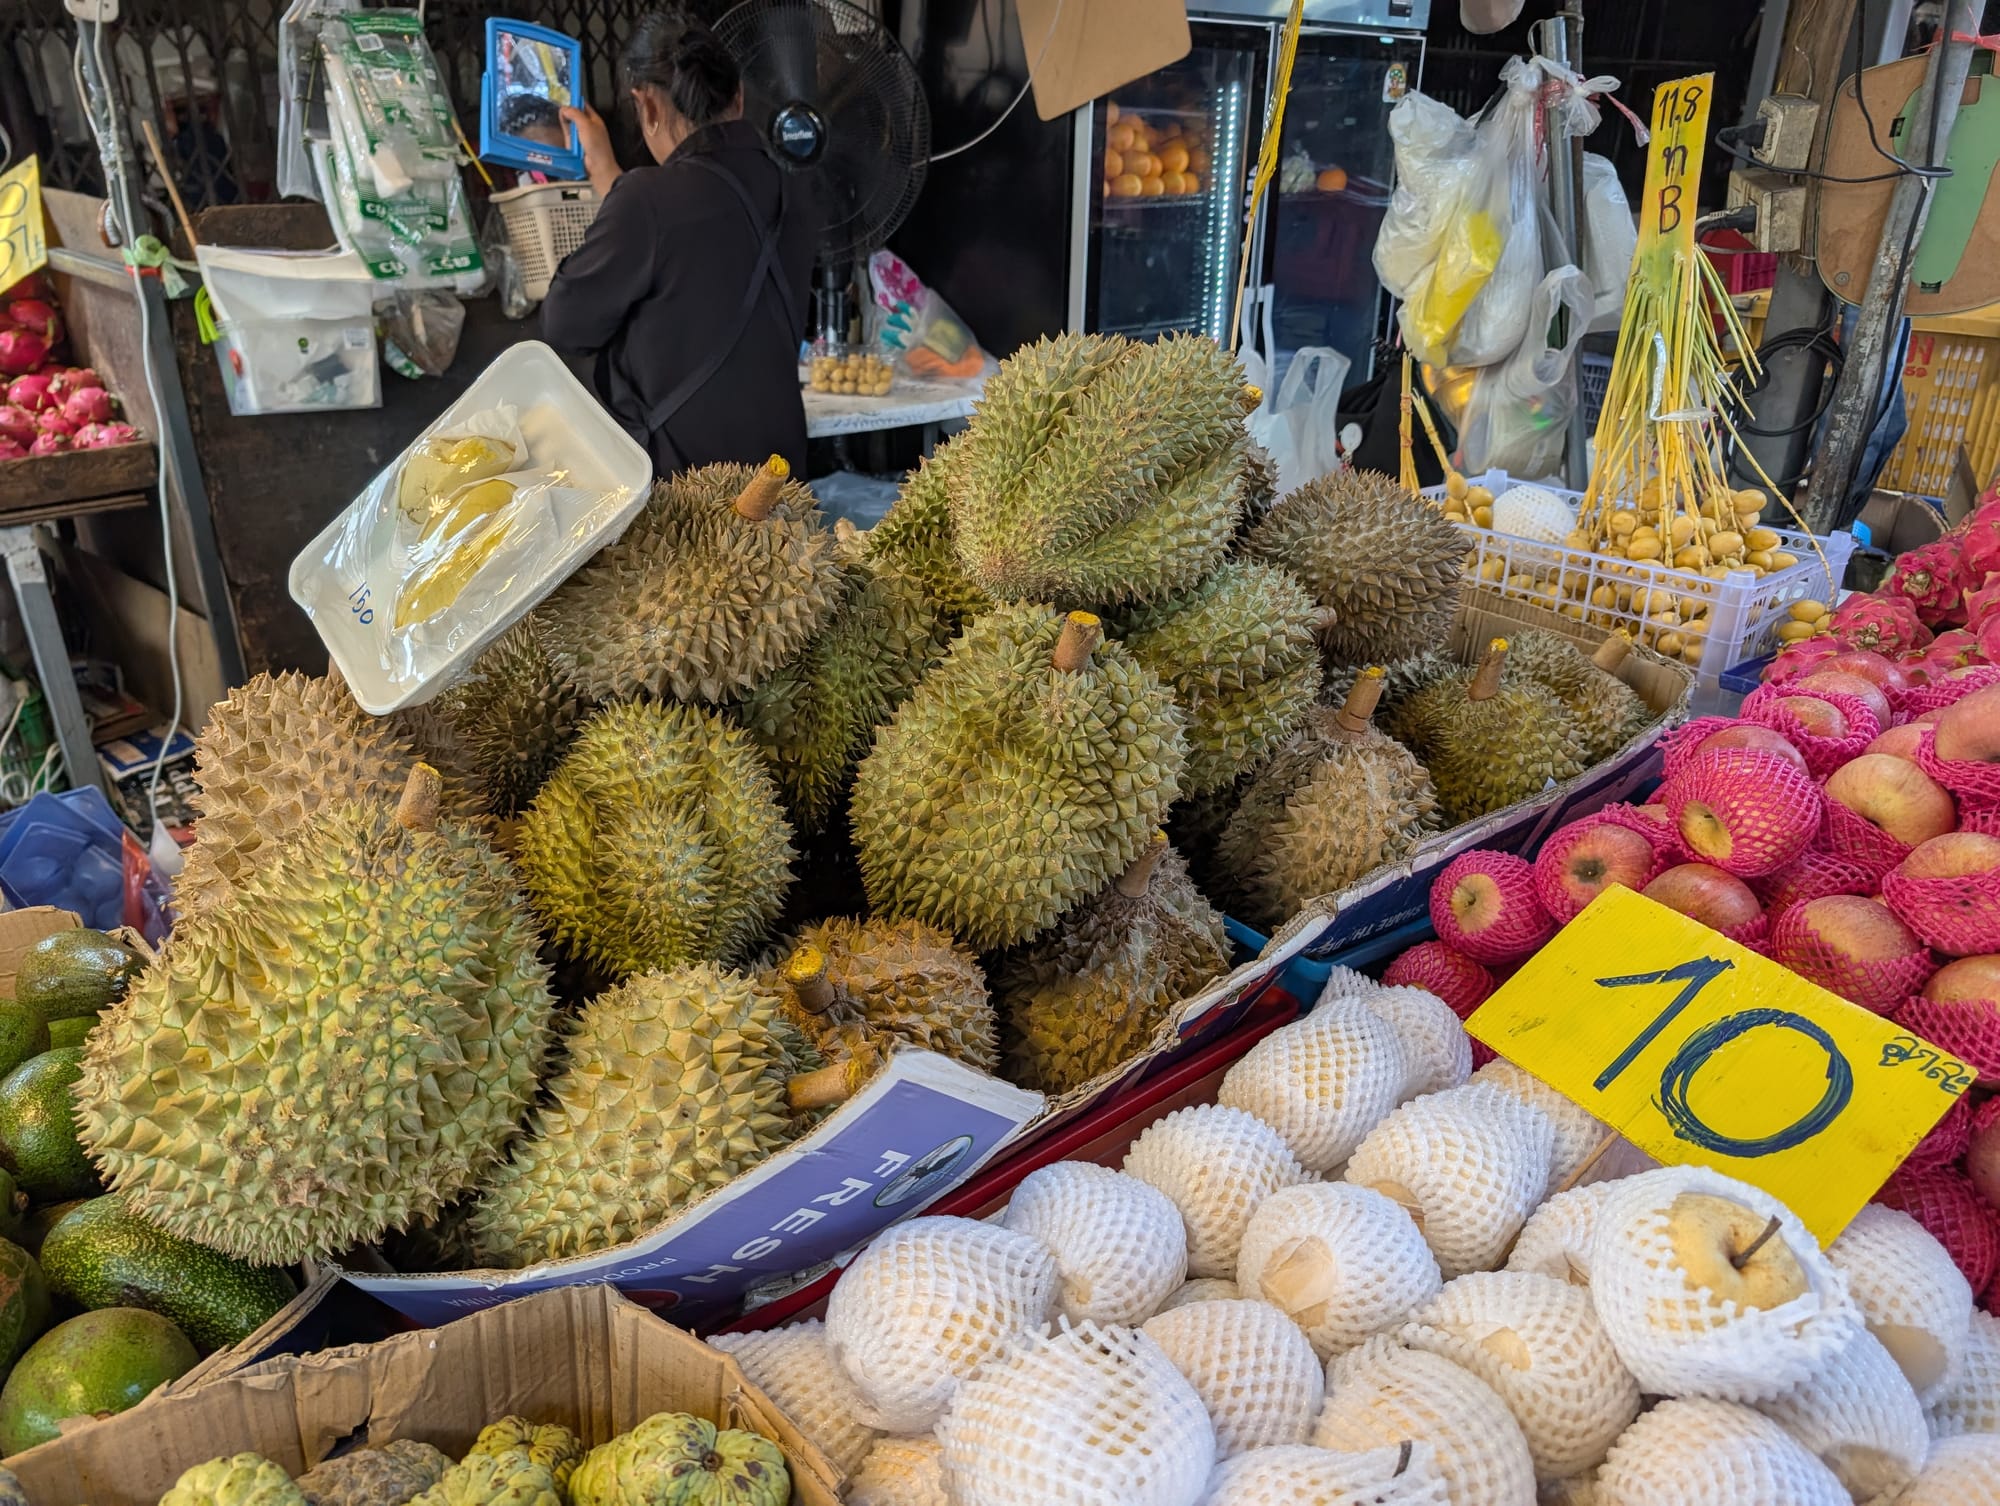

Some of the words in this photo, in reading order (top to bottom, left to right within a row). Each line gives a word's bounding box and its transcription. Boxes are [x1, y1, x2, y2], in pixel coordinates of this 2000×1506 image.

[1659, 184, 1682, 235] B
[349, 581, 374, 625] 150
[1593, 955, 1854, 1158] 10
[681, 1149, 912, 1284] FRESH
